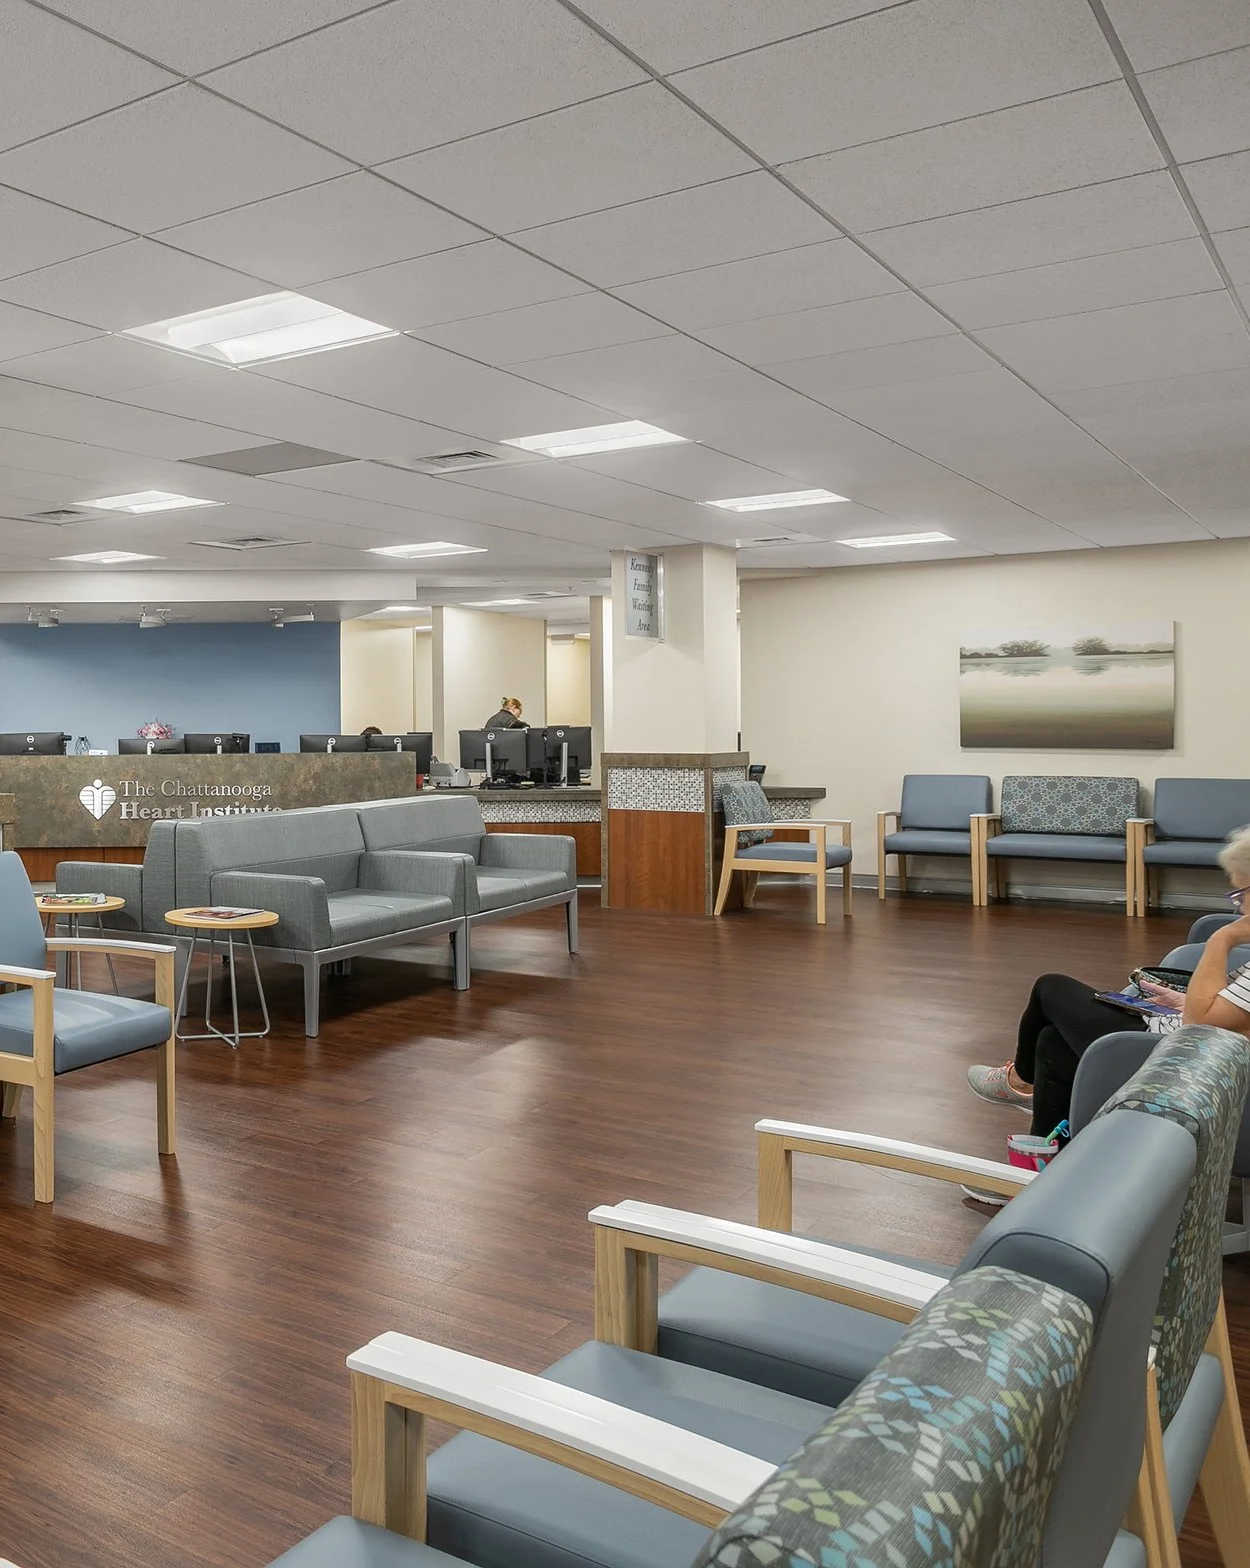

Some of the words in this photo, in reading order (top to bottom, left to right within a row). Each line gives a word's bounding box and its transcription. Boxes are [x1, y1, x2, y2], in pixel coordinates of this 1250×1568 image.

[633, 578, 652, 597] Family
[632, 597, 654, 617] Waiting
[636, 618, 651, 632] Area
[119, 780, 154, 797] The
[161, 780, 272, 801] Chattanooga
[119, 802, 185, 820] Heart
